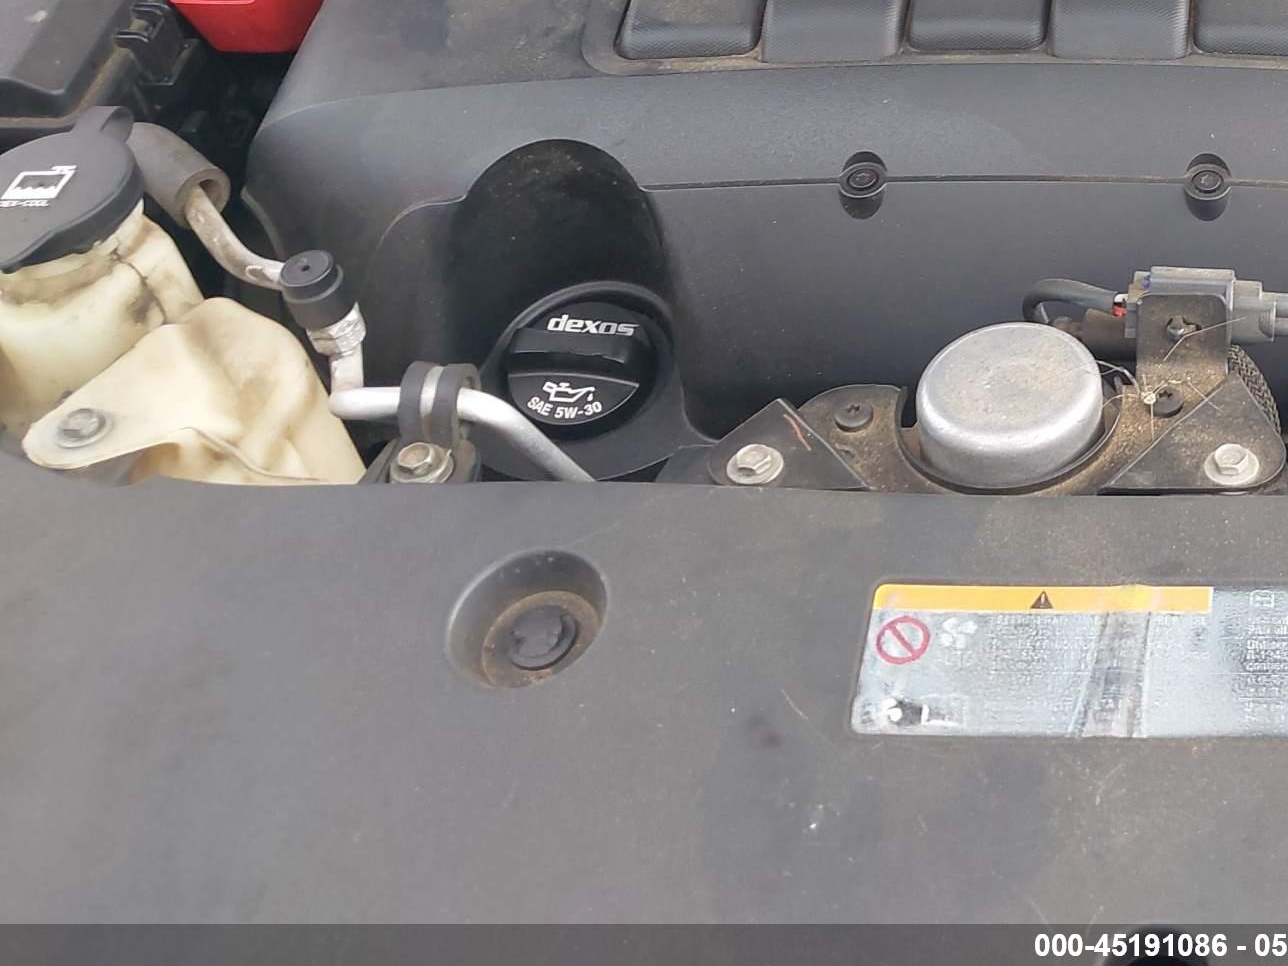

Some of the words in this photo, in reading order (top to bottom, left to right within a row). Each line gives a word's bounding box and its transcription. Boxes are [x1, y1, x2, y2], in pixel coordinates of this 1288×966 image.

[547, 314, 640, 337] dexos
[527, 397, 553, 419] SAE
[554, 401, 602, 419] 5W-30
